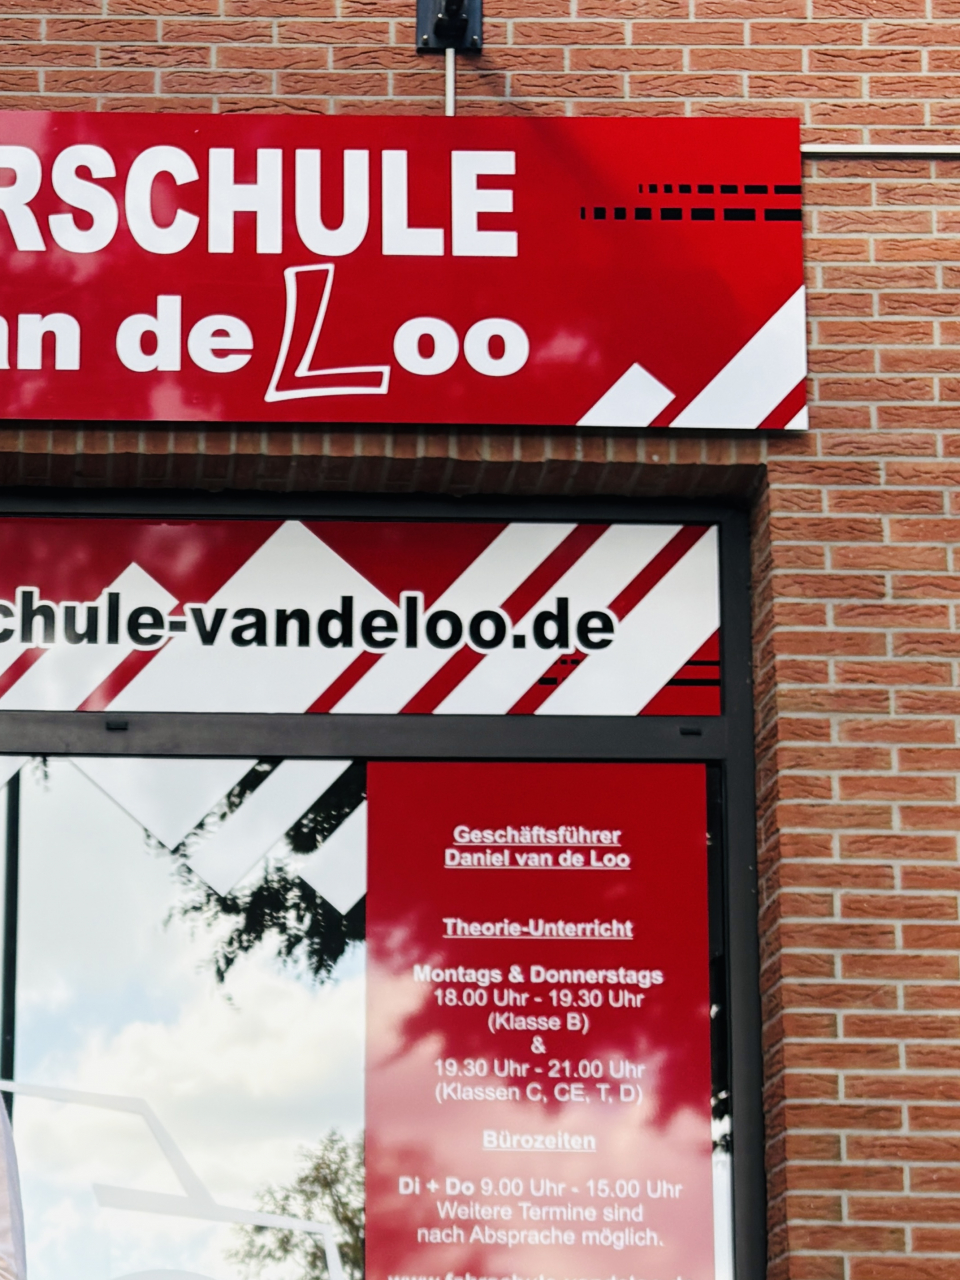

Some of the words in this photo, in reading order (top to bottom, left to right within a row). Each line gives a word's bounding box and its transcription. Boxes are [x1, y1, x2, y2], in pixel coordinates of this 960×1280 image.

[115, 294, 255, 374] de
[265, 263, 530, 403] Loo
[453, 825, 621, 846] Geschäftsführer
[444, 849, 509, 867] Daniel
[516, 853, 553, 868] van
[558, 850, 584, 868] de
[591, 850, 631, 869] Loo
[443, 918, 633, 939] Theorie-Unterricht
[413, 964, 502, 986] Montags
[507, 964, 524, 982] &
[530, 965, 664, 988] Donnerstags
[435, 989, 487, 1006] 18.00
[493, 989, 529, 1007] Uhr
[548, 989, 602, 1007] 19.30
[609, 989, 644, 1008] Uhr
[488, 1012, 560, 1034] (Klasse
[566, 1013, 589, 1034] B)
[530, 1036, 546, 1054] &
[435, 1060, 487, 1077] 19.30
[493, 1060, 530, 1078] Uhr
[548, 1060, 603, 1078] 21.00
[609, 1060, 645, 1079] Uhr
[435, 1083, 520, 1103] (Klassen
[526, 1084, 548, 1103] C,
[554, 1084, 590, 1103] CE,
[596, 1084, 613, 1104] T,
[620, 1085, 643, 1105] D)
[483, 1130, 596, 1151] Bürozeiten
[398, 1177, 420, 1195] Di
[426, 1179, 439, 1193] +
[445, 1178, 474, 1196] Do
[480, 1178, 523, 1197] 9.00
[530, 1178, 566, 1197] Uhr
[587, 1179, 640, 1198] 15.00
[647, 1180, 683, 1199] Uhr
[436, 1201, 512, 1221] Weitere
[518, 1202, 596, 1222] Termine
[603, 1203, 644, 1222] sind
[417, 1226, 464, 1244] nach
[470, 1227, 575, 1248] Absprache
[582, 1228, 664, 1250] möglich.
